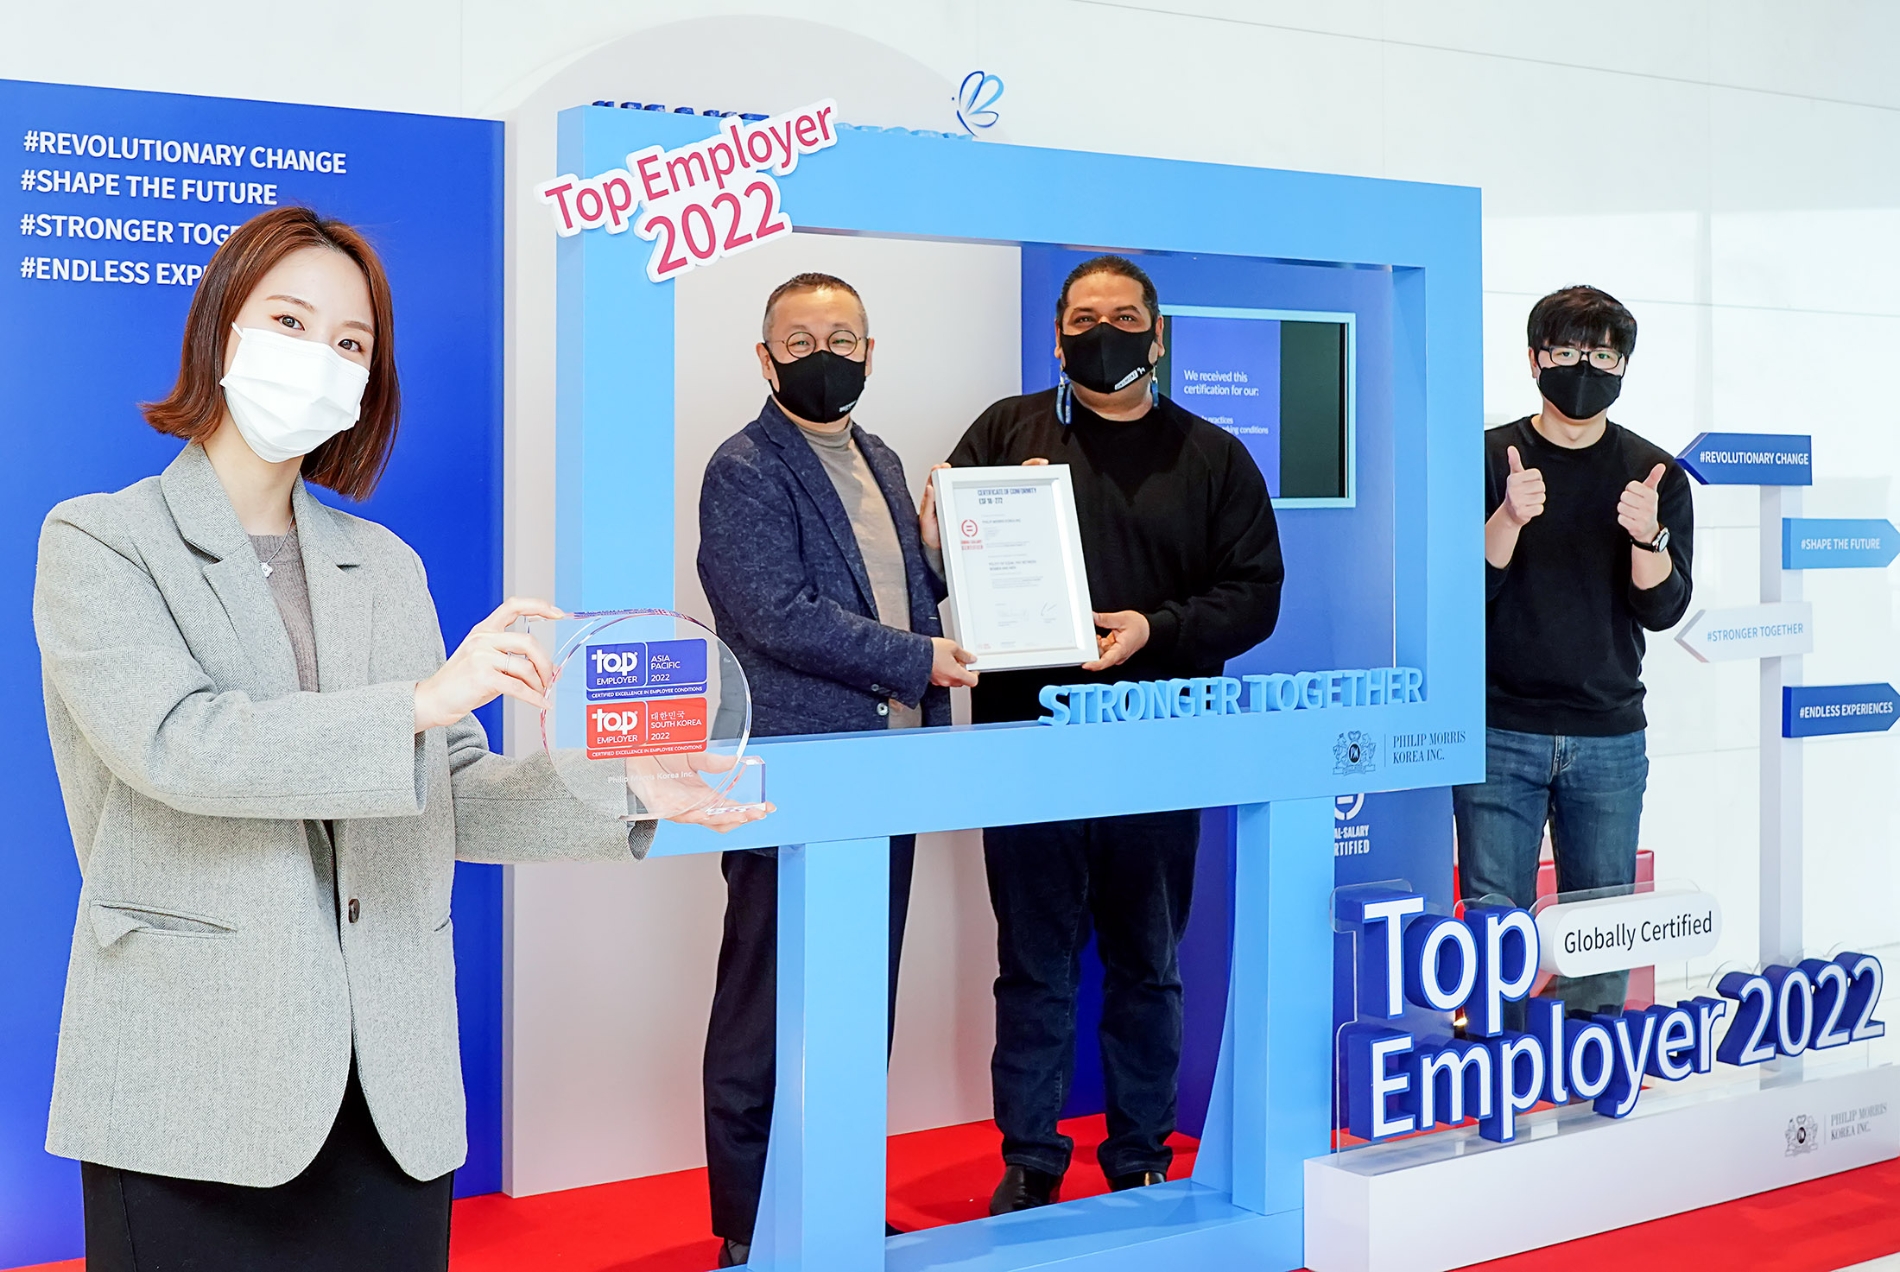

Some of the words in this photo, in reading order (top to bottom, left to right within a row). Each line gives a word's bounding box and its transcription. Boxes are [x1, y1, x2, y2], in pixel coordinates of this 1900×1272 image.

[23, 130, 245, 167] #REVOLUTIONARY
[250, 147, 347, 174] CHANGE
[544, 177, 632, 230] Top
[636, 106, 833, 202] Employer
[20, 169, 120, 196] #SHAPE
[126, 175, 175, 200] THE
[182, 179, 278, 205] FUTURE
[20, 213, 174, 244] #STRONGER
[644, 180, 785, 275] 2022
[20, 256, 150, 284] #ENDLESS
[156, 263, 208, 286] EXP
[1184, 370, 1198, 380] We
[1200, 371, 1232, 382] received
[1233, 371, 1248, 383] this
[1184, 384, 1230, 395] certification
[1231, 385, 1243, 396] for
[1243, 387, 1259, 396] our:
[1240, 425, 1269, 434] conditions
[1700, 451, 1774, 464] #REVOLUTIONARY
[1775, 453, 1809, 465] CHANGE
[1801, 538, 1832, 550] #SHAPE
[1833, 538, 1849, 550] THE
[1850, 538, 1881, 550] FUTURE
[1707, 628, 1758, 642] #STRONGER
[1760, 623, 1804, 637] TOGETHER
[591, 649, 638, 676] top
[651, 655, 670, 663] ASIA
[651, 661, 680, 670] PACIFIC
[597, 676, 638, 685] EMPLOYER
[651, 674, 670, 682] 2022
[1038, 677, 1242, 726] STRONGER
[1243, 667, 1428, 713] TOGETHER
[651, 711, 685, 720] 대한민국
[1799, 705, 1840, 719] #ENDLESS
[1841, 701, 1893, 716] EXPERIENCES
[591, 708, 638, 735] top
[651, 721, 676, 729] SOUTH
[676, 719, 702, 727] KOREA
[597, 734, 638, 744] EMPLOYER
[651, 732, 670, 740] 2022
[1393, 733, 1427, 748] PHILIP
[1429, 730, 1466, 746] MORRIS
[1393, 750, 1424, 764] KOREA
[1427, 749, 1445, 761] INC.
[657, 772, 679, 780] Korea
[1564, 922, 1636, 954] Globally
[1641, 911, 1713, 942] Certified
[1362, 894, 1541, 1037] Top
[1360, 997, 1727, 1142] Employer
[1732, 952, 1887, 1066] 2022
[1831, 1109, 1857, 1126] PHILIP
[1859, 1102, 1888, 1119] MORRIS
[1831, 1126, 1855, 1141] KOREA
[1857, 1121, 1871, 1134] INC.
